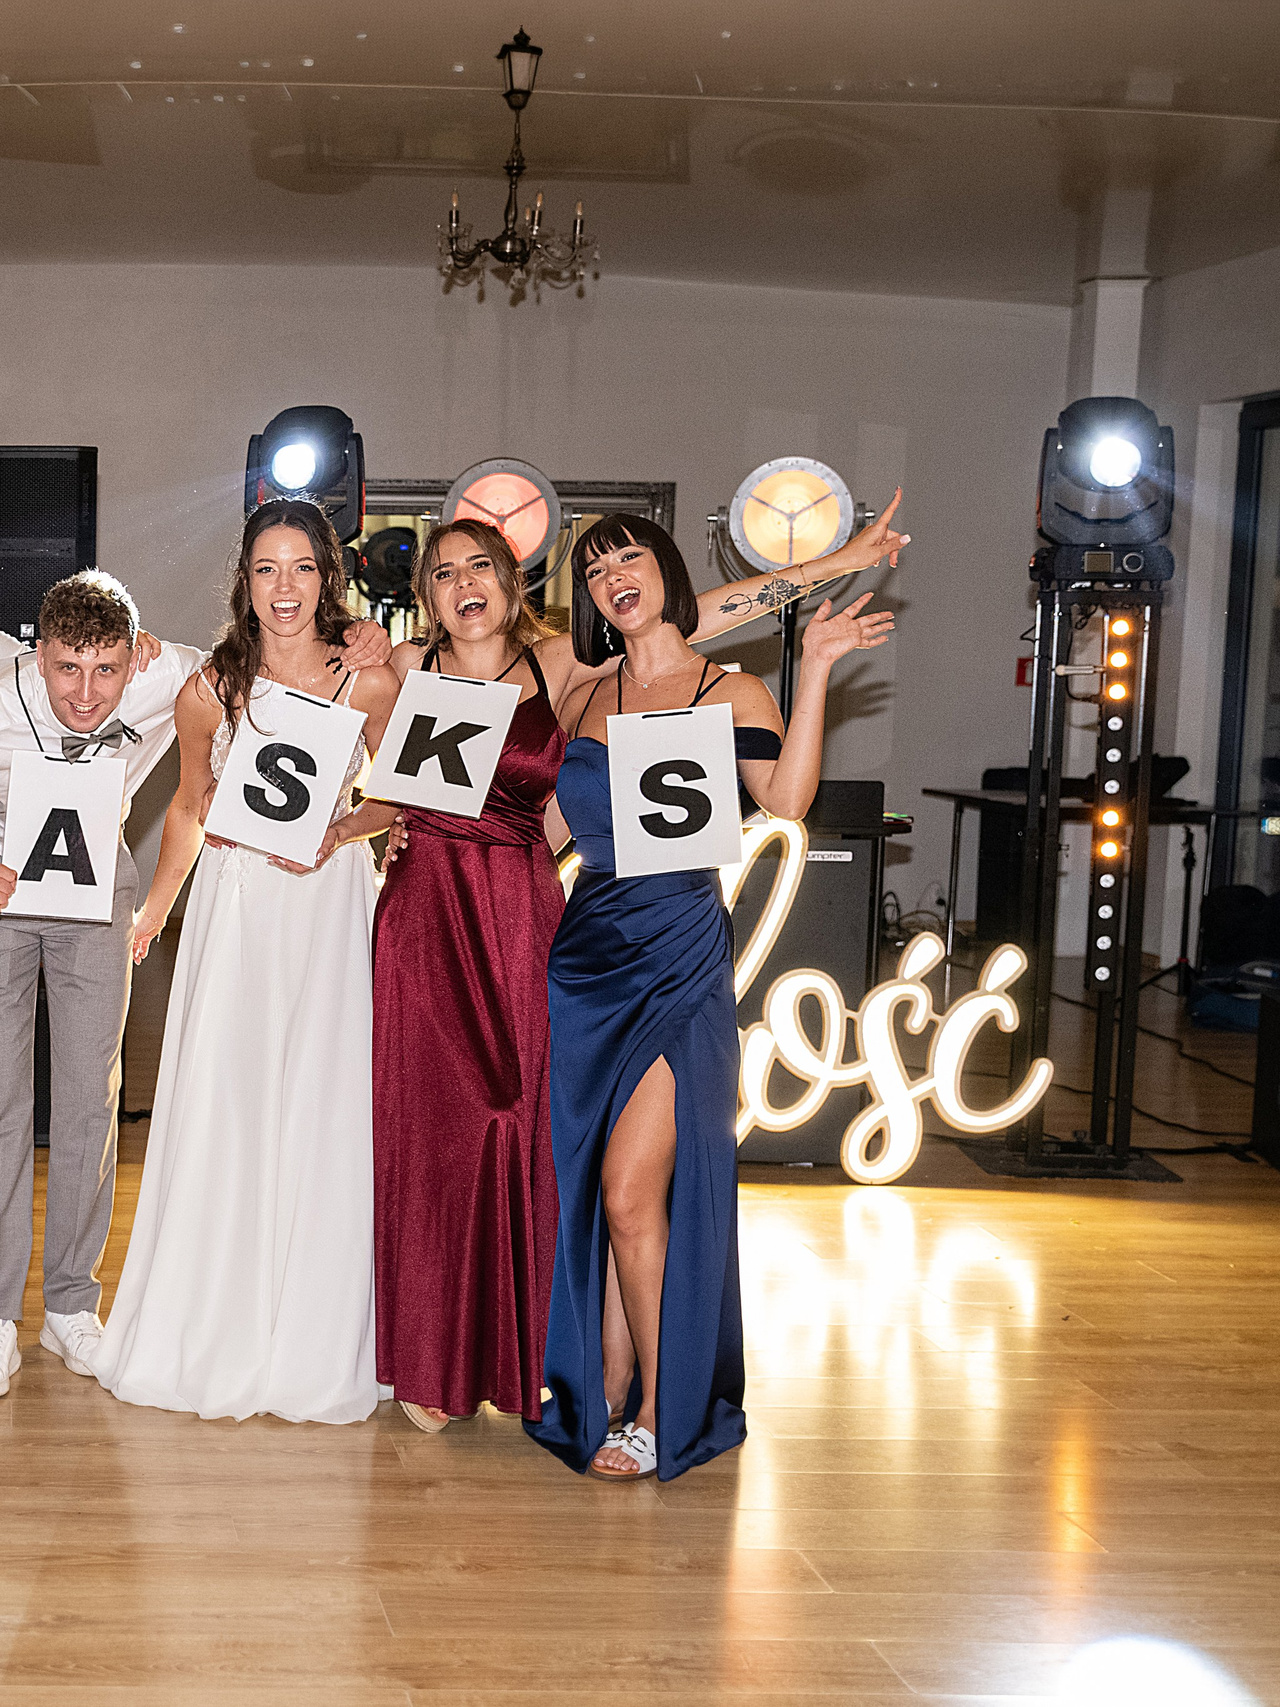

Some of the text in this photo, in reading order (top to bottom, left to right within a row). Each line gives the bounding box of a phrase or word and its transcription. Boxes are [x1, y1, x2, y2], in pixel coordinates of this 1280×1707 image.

[244, 743, 316, 821] S
[394, 714, 492, 788] K
[639, 760, 712, 838] S
[19, 808, 97, 886] A
